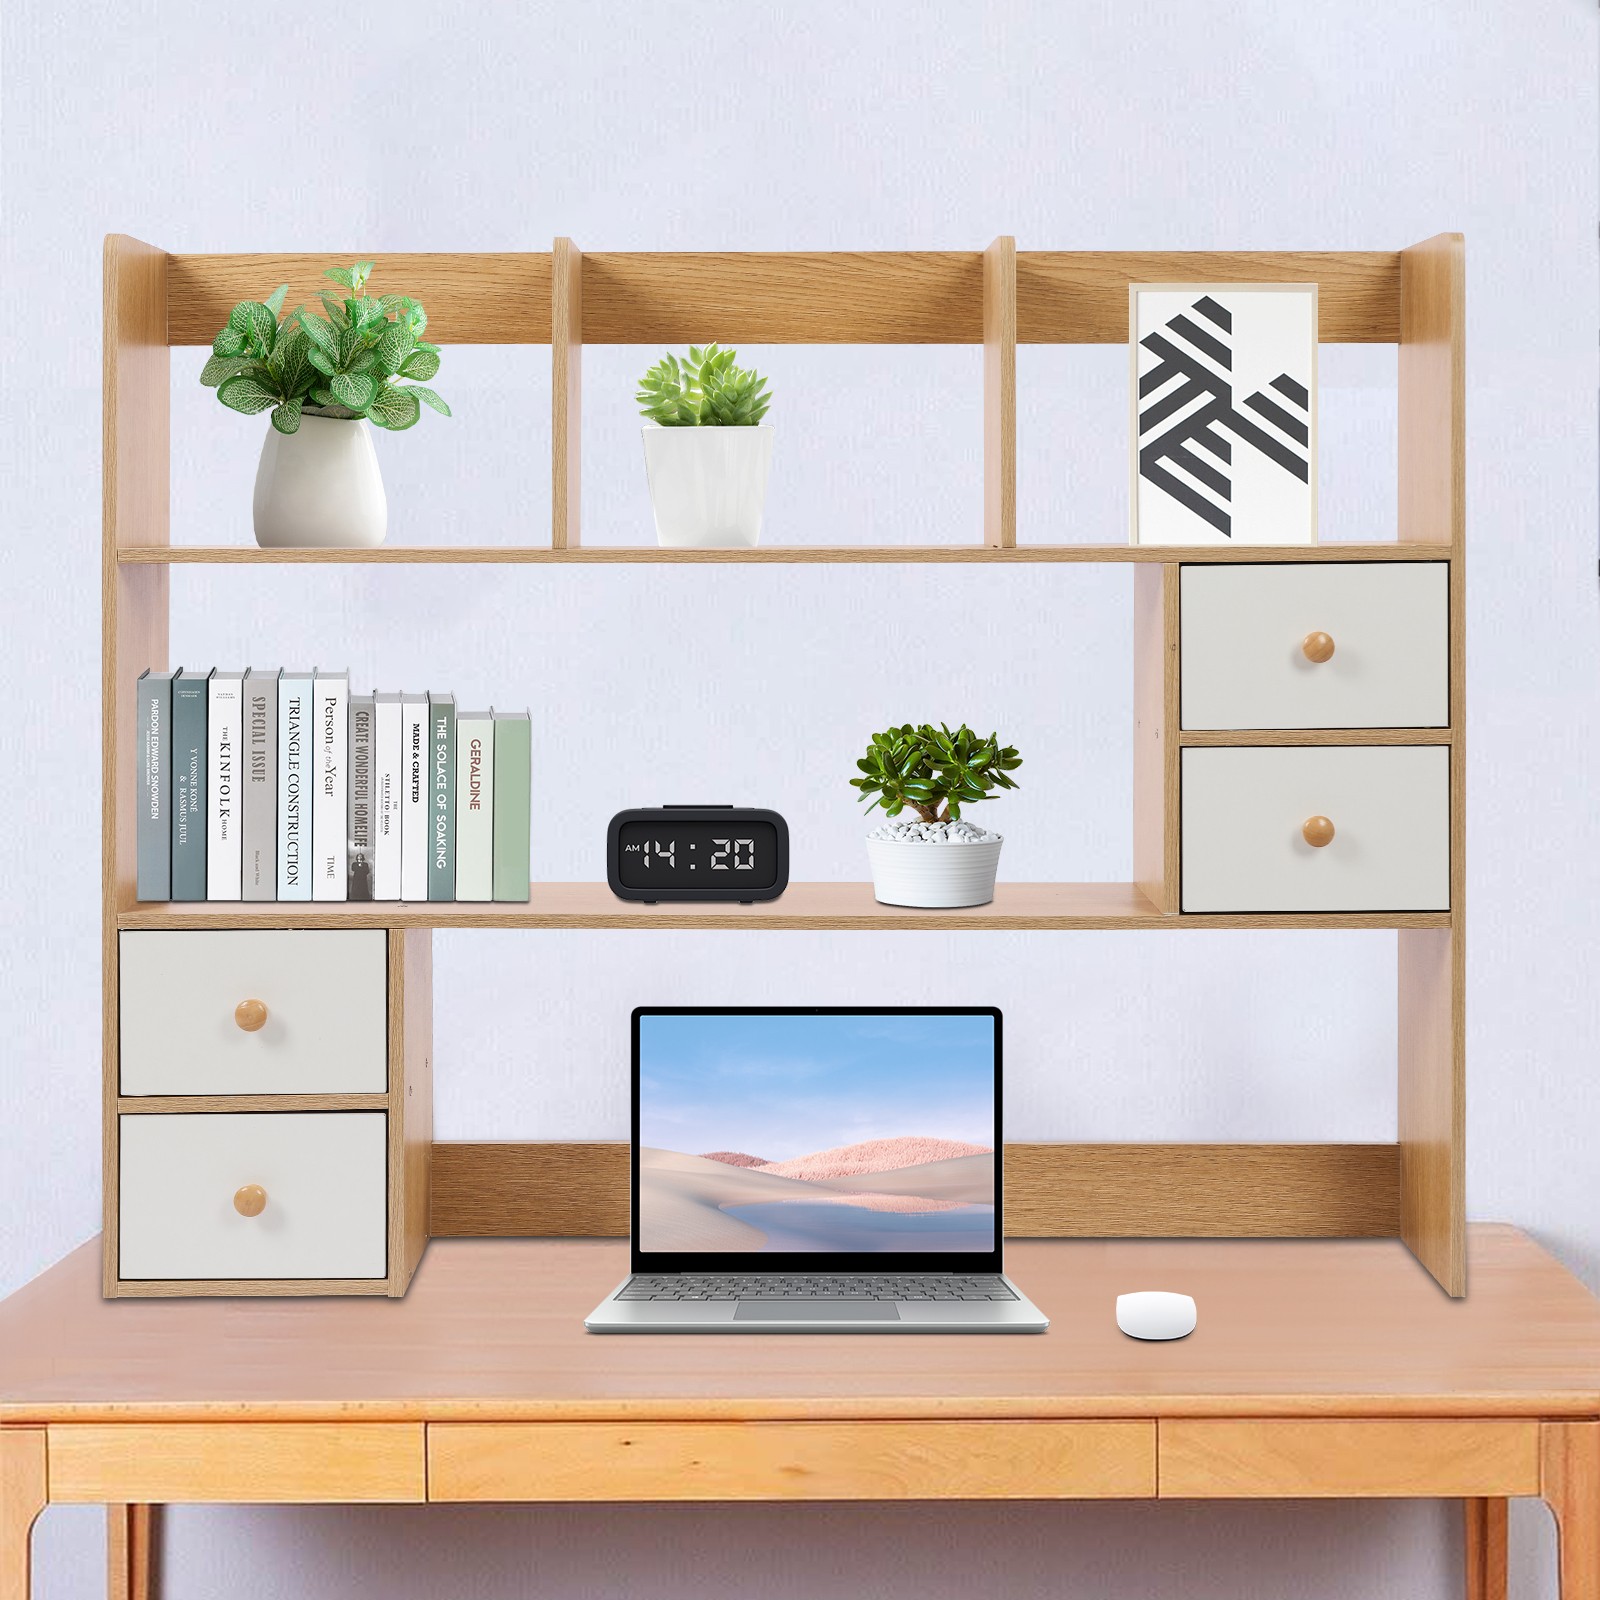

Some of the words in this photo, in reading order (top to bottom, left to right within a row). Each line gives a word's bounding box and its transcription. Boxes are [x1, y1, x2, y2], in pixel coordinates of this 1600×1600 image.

[150, 699, 159, 735] PARDON
[252, 696, 266, 745] SPECIAL
[288, 697, 300, 770] TRIANGLE
[324, 697, 336, 744] Person
[355, 711, 370, 743] CREATE
[436, 716, 447, 740] THE
[150, 736, 159, 774] EDWARD
[324, 746, 333, 755] of
[412, 723, 420, 751] MADE
[252, 750, 266, 783] ISSUE
[354, 746, 370, 801] WONDERFUL
[412, 752, 420, 760] &
[436, 744, 447, 790] SOLACE
[470, 738, 482, 810] GERALDINE
[150, 775, 159, 820] SNOWDEN
[219, 742, 231, 818] KINFOLK
[325, 766, 337, 797] Year
[412, 761, 420, 804] CRAFTED
[179, 788, 187, 823] RASMUS
[190, 788, 199, 812] KONÉ
[436, 794, 447, 811] OF
[179, 824, 187, 845] JUUL
[286, 774, 300, 886] CONSTRUCTION
[354, 803, 369, 848] HOMELIFE
[436, 814, 447, 870] SOAKING
[326, 856, 335, 879] TIME
